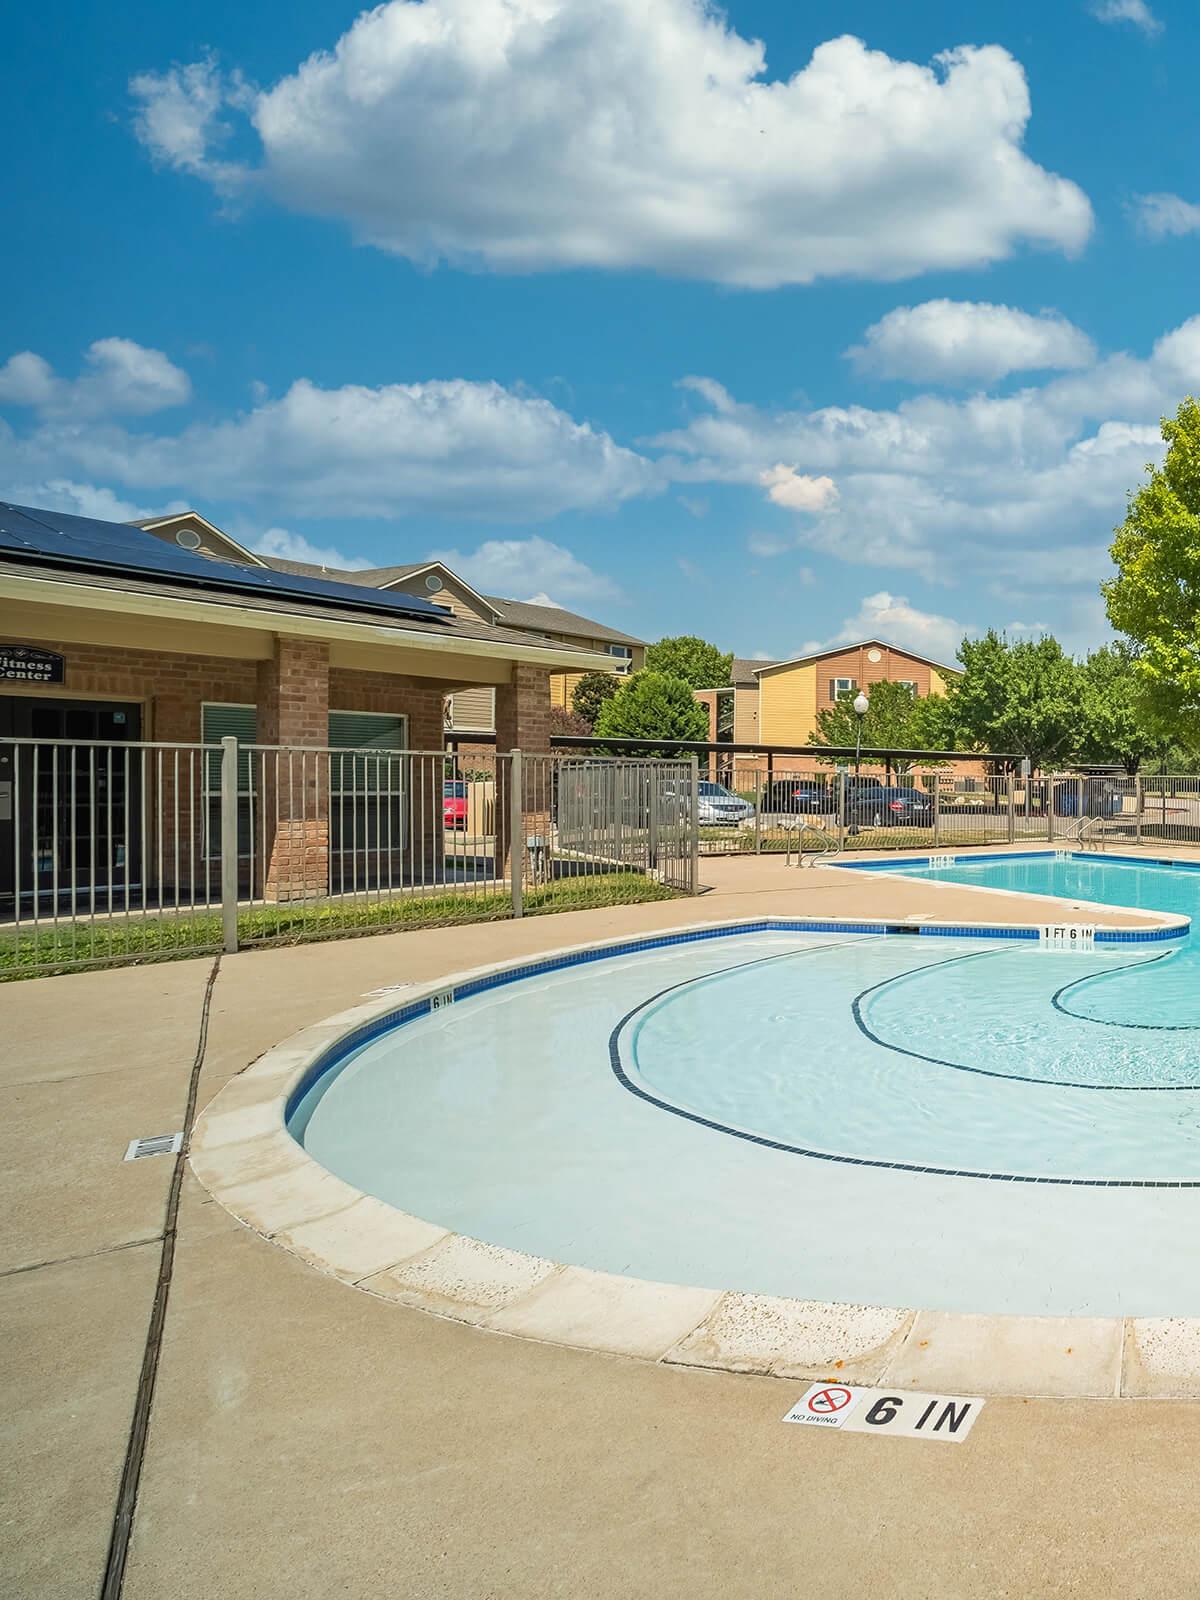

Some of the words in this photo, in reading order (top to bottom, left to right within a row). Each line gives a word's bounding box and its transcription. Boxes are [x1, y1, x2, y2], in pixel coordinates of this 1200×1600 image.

[0, 657, 52, 671] itness
[1045, 927, 1049, 938] 1
[1054, 928, 1066, 939] FT
[1070, 928, 1077, 939] 6
[1082, 929, 1092, 938] IN
[433, 996, 440, 1008] 6
[443, 992, 453, 1005] IN
[790, 1413, 805, 1421] NO
[806, 1414, 838, 1424] DIVING
[865, 1397, 904, 1425] 6
[914, 1400, 972, 1433] IN
